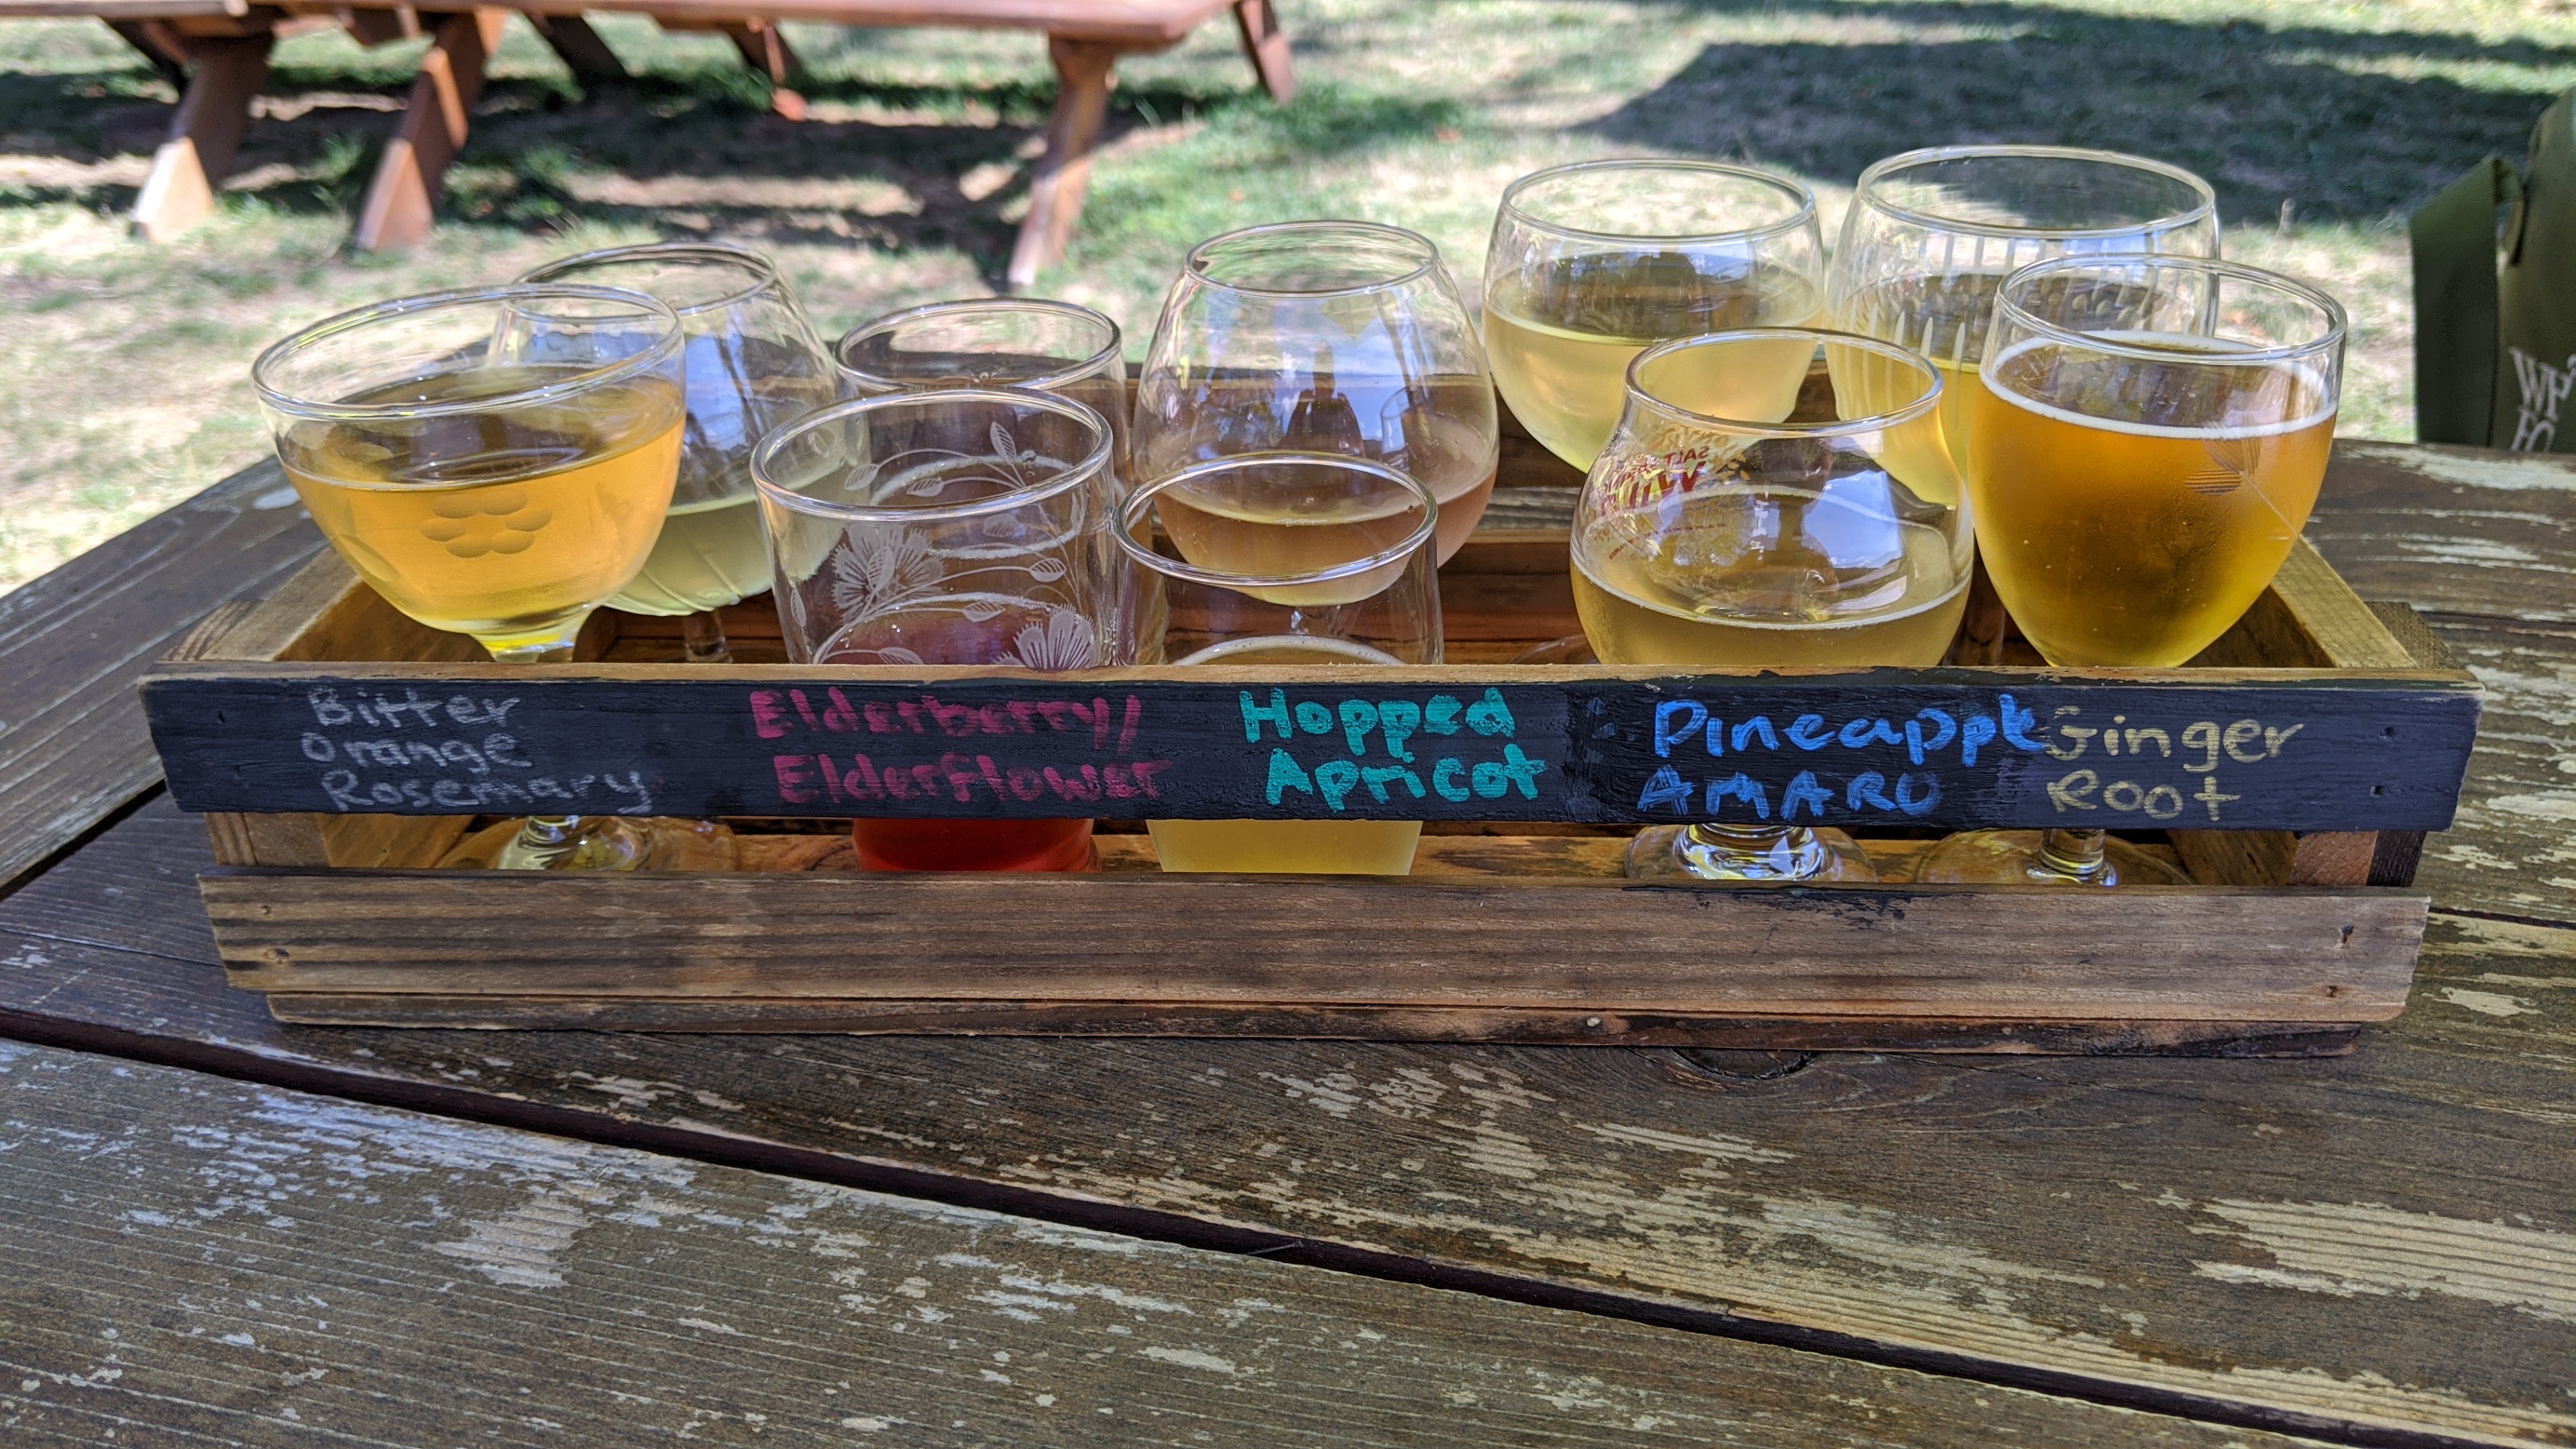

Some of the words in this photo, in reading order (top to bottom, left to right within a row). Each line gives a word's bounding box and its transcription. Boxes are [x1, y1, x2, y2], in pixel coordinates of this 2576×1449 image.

[307, 686, 521, 727] Bitter
[1239, 687, 1515, 763] Hopped
[301, 732, 533, 774] Orange
[2044, 705, 2305, 772] Ginger
[321, 769, 652, 814] Rosemary
[1266, 743, 1546, 814] Apricot
[1637, 764, 1944, 820] AMARO
[2046, 769, 2241, 822] Root
